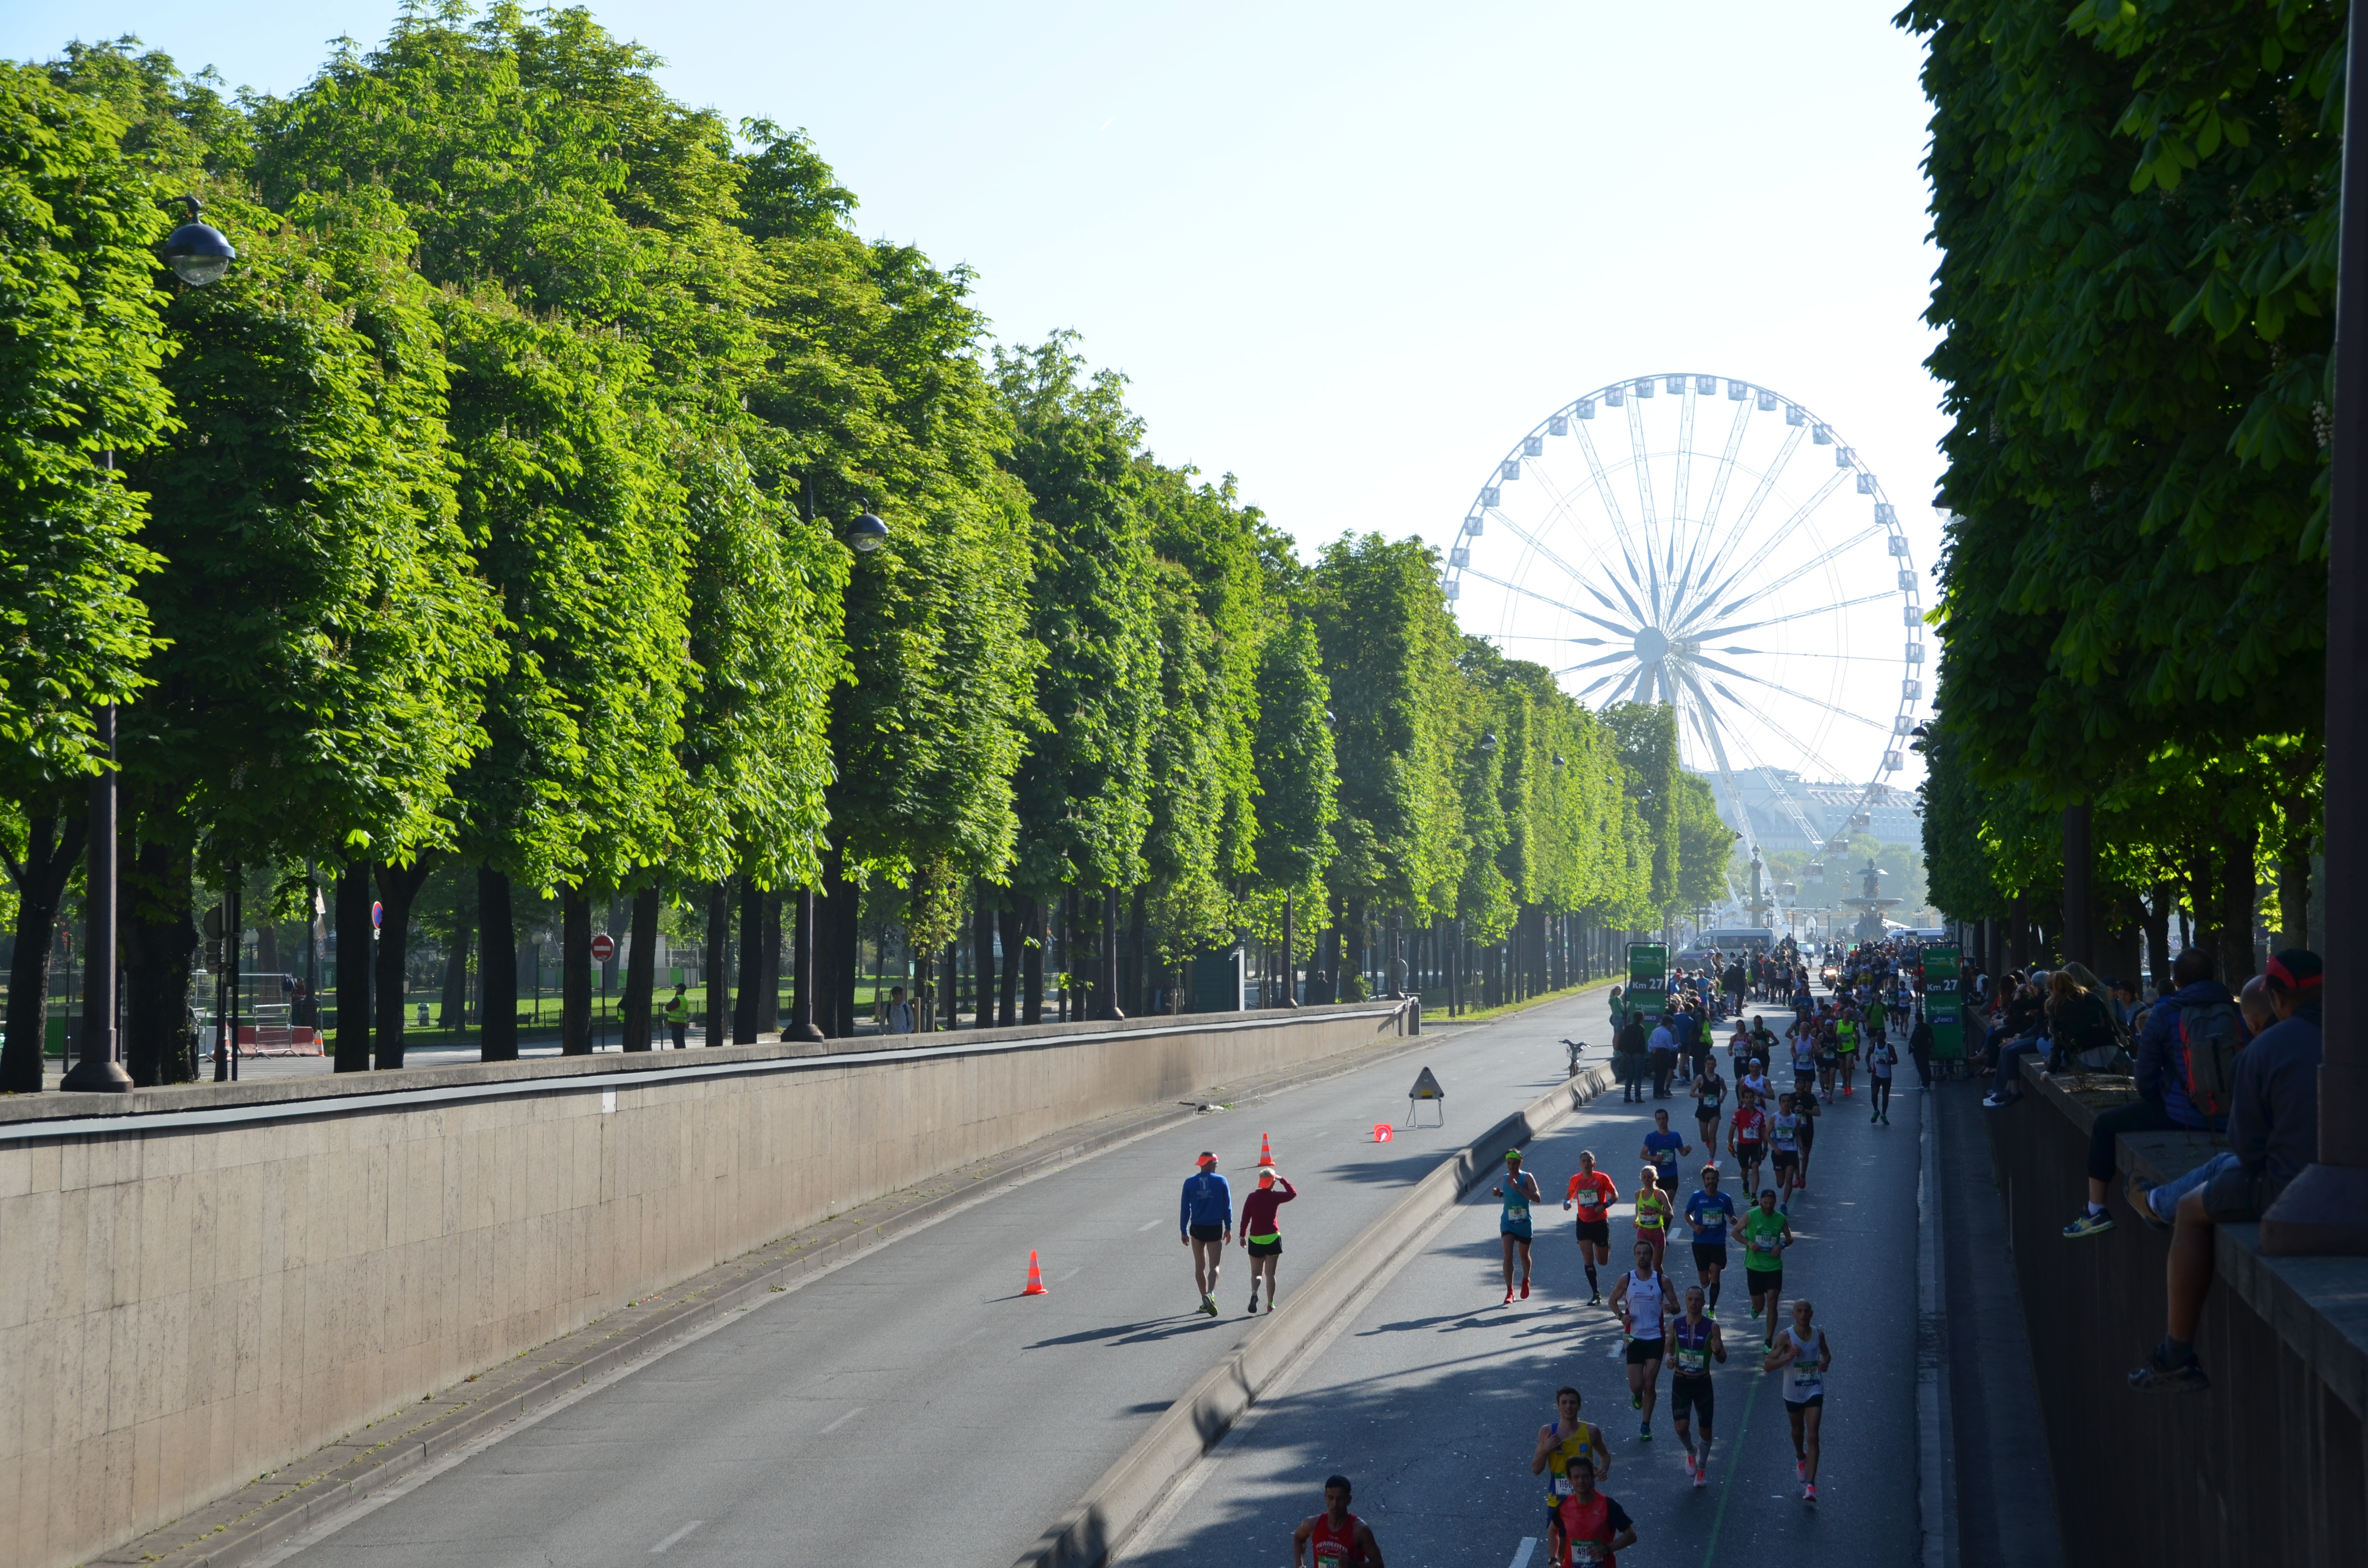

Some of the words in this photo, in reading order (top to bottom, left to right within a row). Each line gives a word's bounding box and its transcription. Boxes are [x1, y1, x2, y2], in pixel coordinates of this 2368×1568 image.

[1649, 978, 1664, 990] 27
[1943, 980, 1958, 991] 27
[1316, 1541, 1348, 1554] PIERREFITTE
